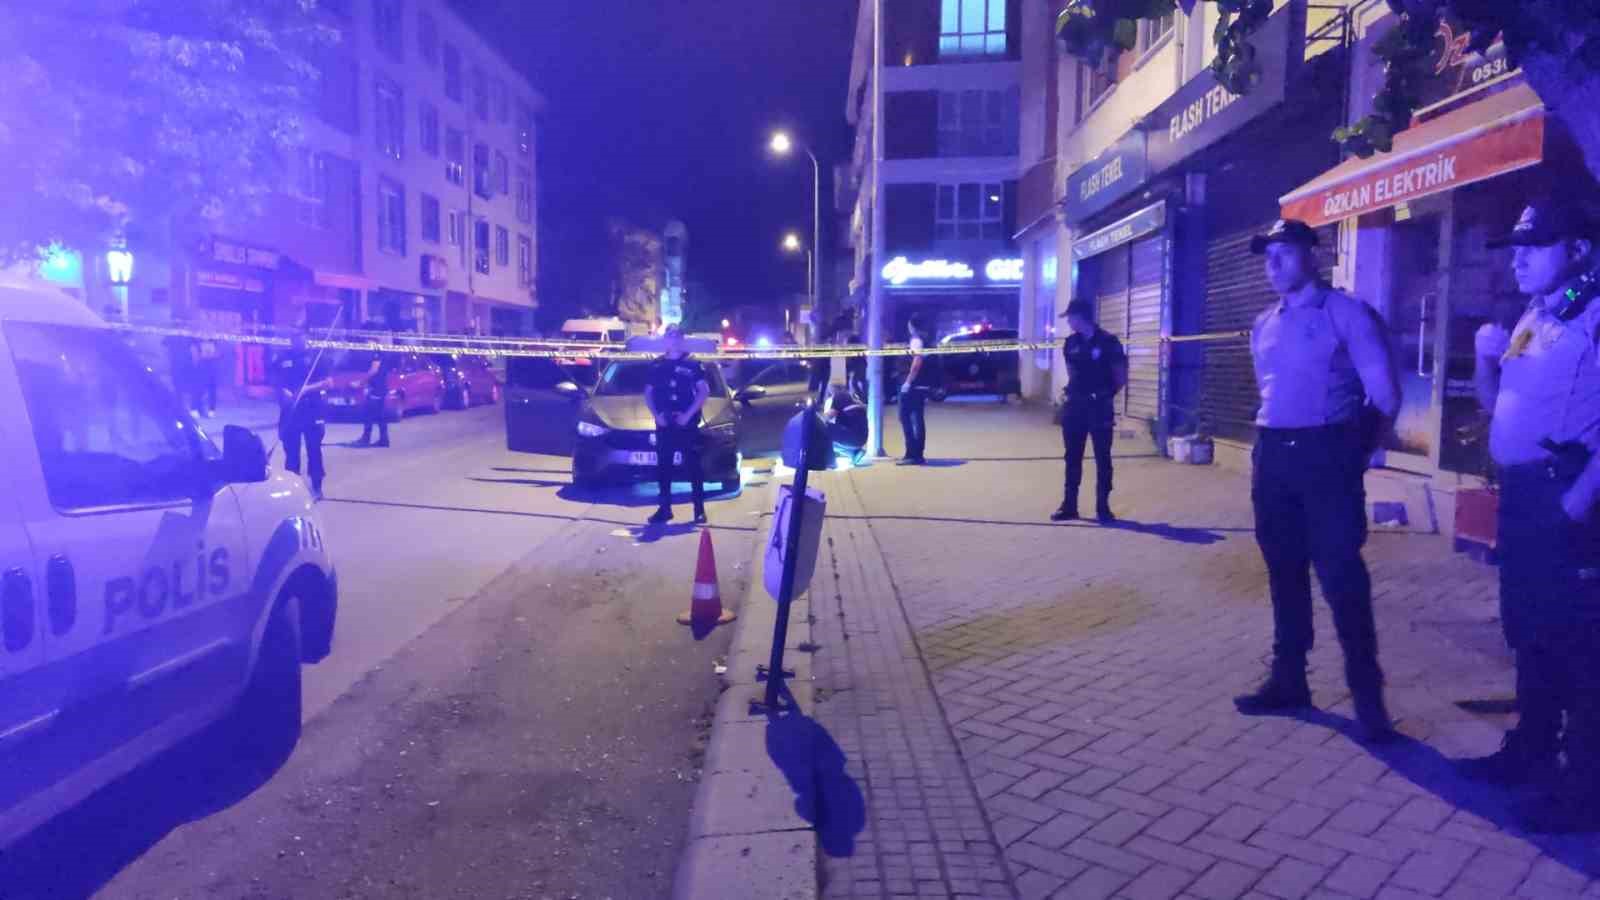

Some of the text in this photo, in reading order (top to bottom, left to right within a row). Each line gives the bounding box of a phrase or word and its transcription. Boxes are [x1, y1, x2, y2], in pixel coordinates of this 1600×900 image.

[1169, 97, 1203, 143] FLASH
[1080, 156, 1123, 201] FLASH TEKEL
[1323, 152, 1457, 217] ÖZKAN ELEKTRİK
[104, 539, 230, 635] POLİS
